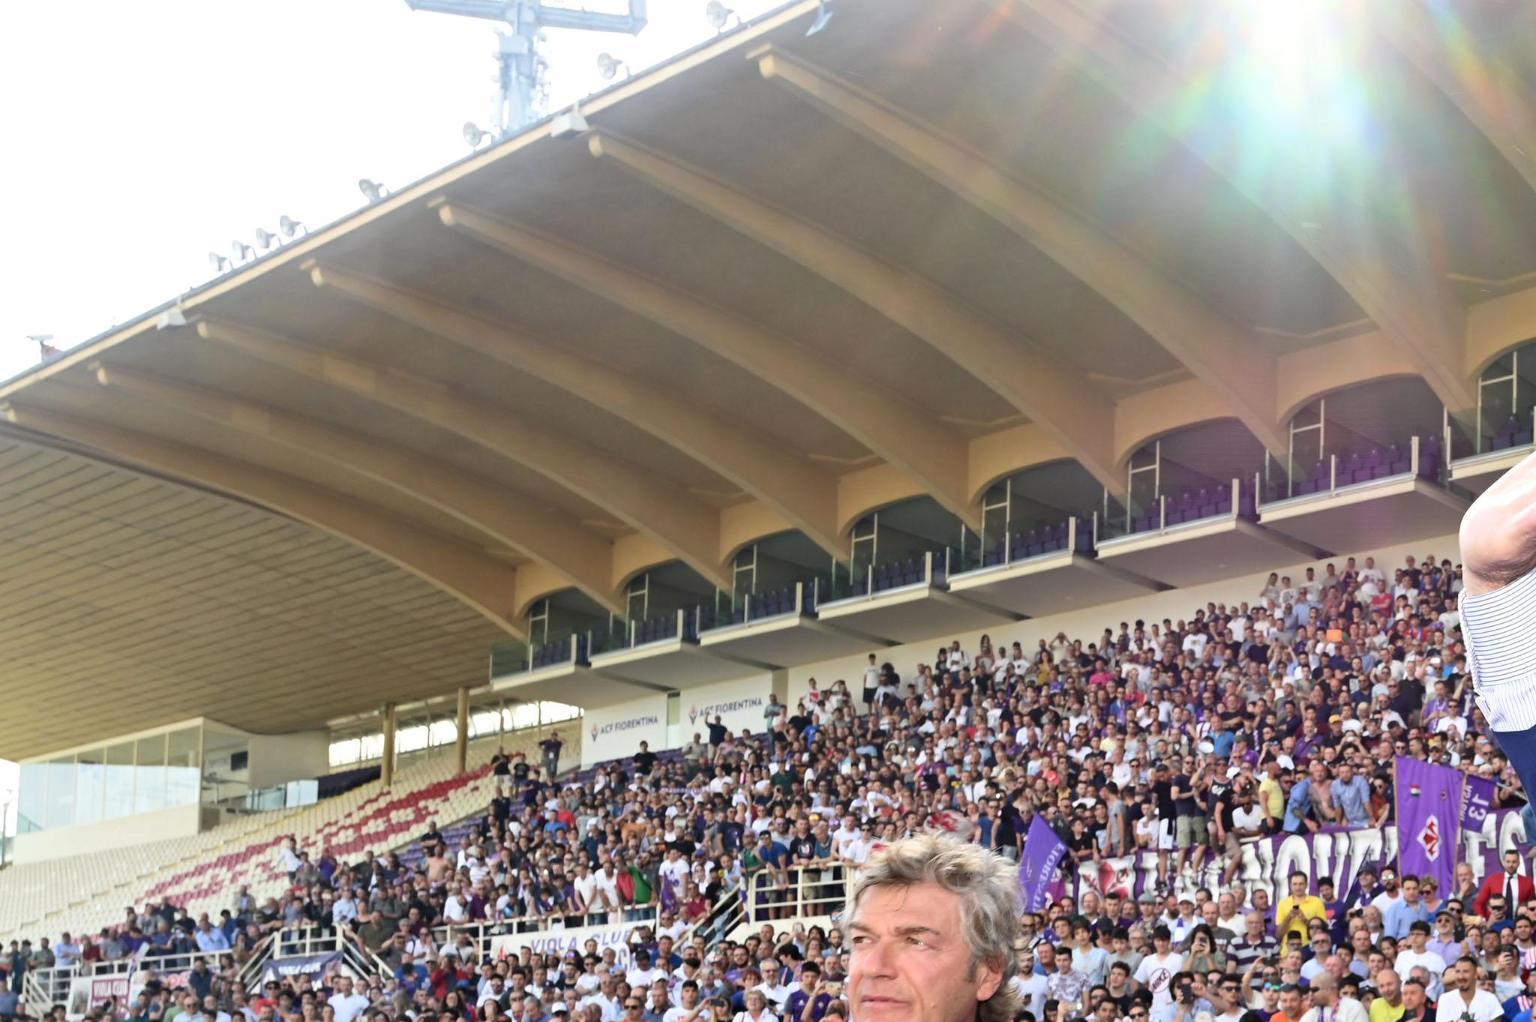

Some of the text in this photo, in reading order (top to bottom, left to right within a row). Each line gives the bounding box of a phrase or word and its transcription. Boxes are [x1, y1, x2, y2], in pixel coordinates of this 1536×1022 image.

[715, 698, 762, 714] FIORENTINA
[600, 716, 659, 734] ACF FIORENTINA
[531, 936, 578, 951] VIOLA
